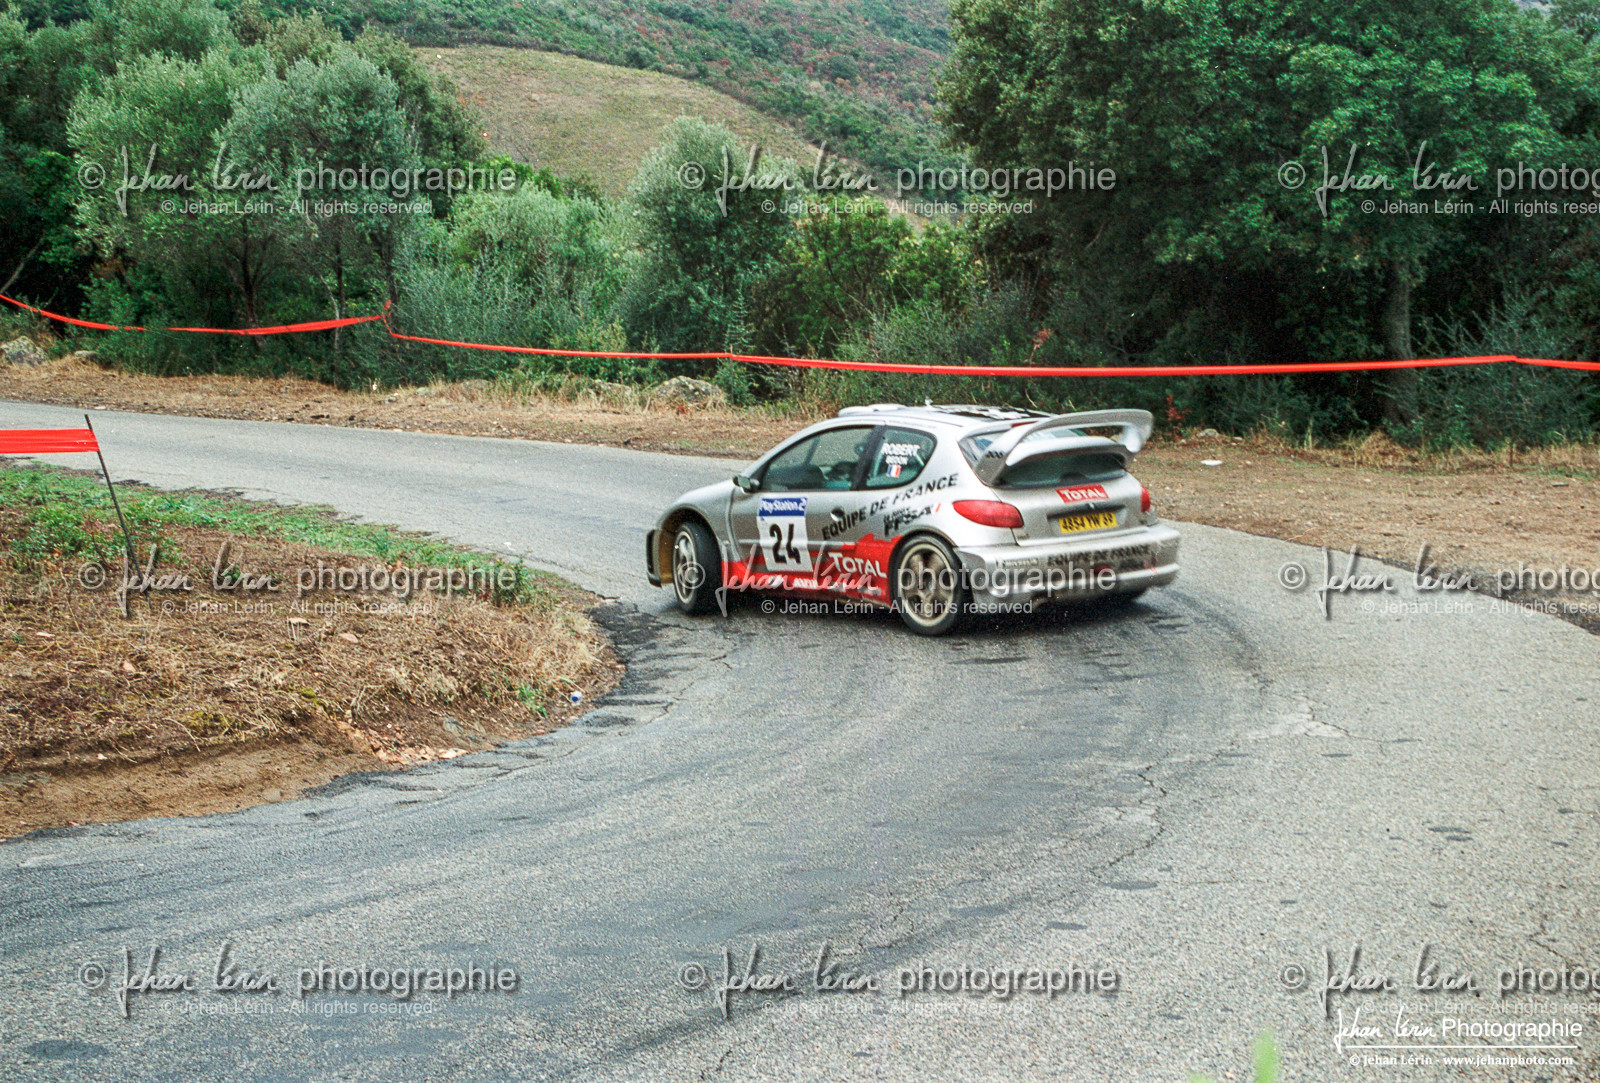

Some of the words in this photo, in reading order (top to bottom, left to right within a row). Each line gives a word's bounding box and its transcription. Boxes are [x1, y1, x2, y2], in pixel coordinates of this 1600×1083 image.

[820, 506, 867, 541] EQUIPE
[869, 496, 890, 517] DE
[892, 472, 959, 505] FRANCE
[1059, 488, 1107, 500] TOTAL
[769, 523, 802, 564] 24
[828, 552, 888, 578] TOTAL
